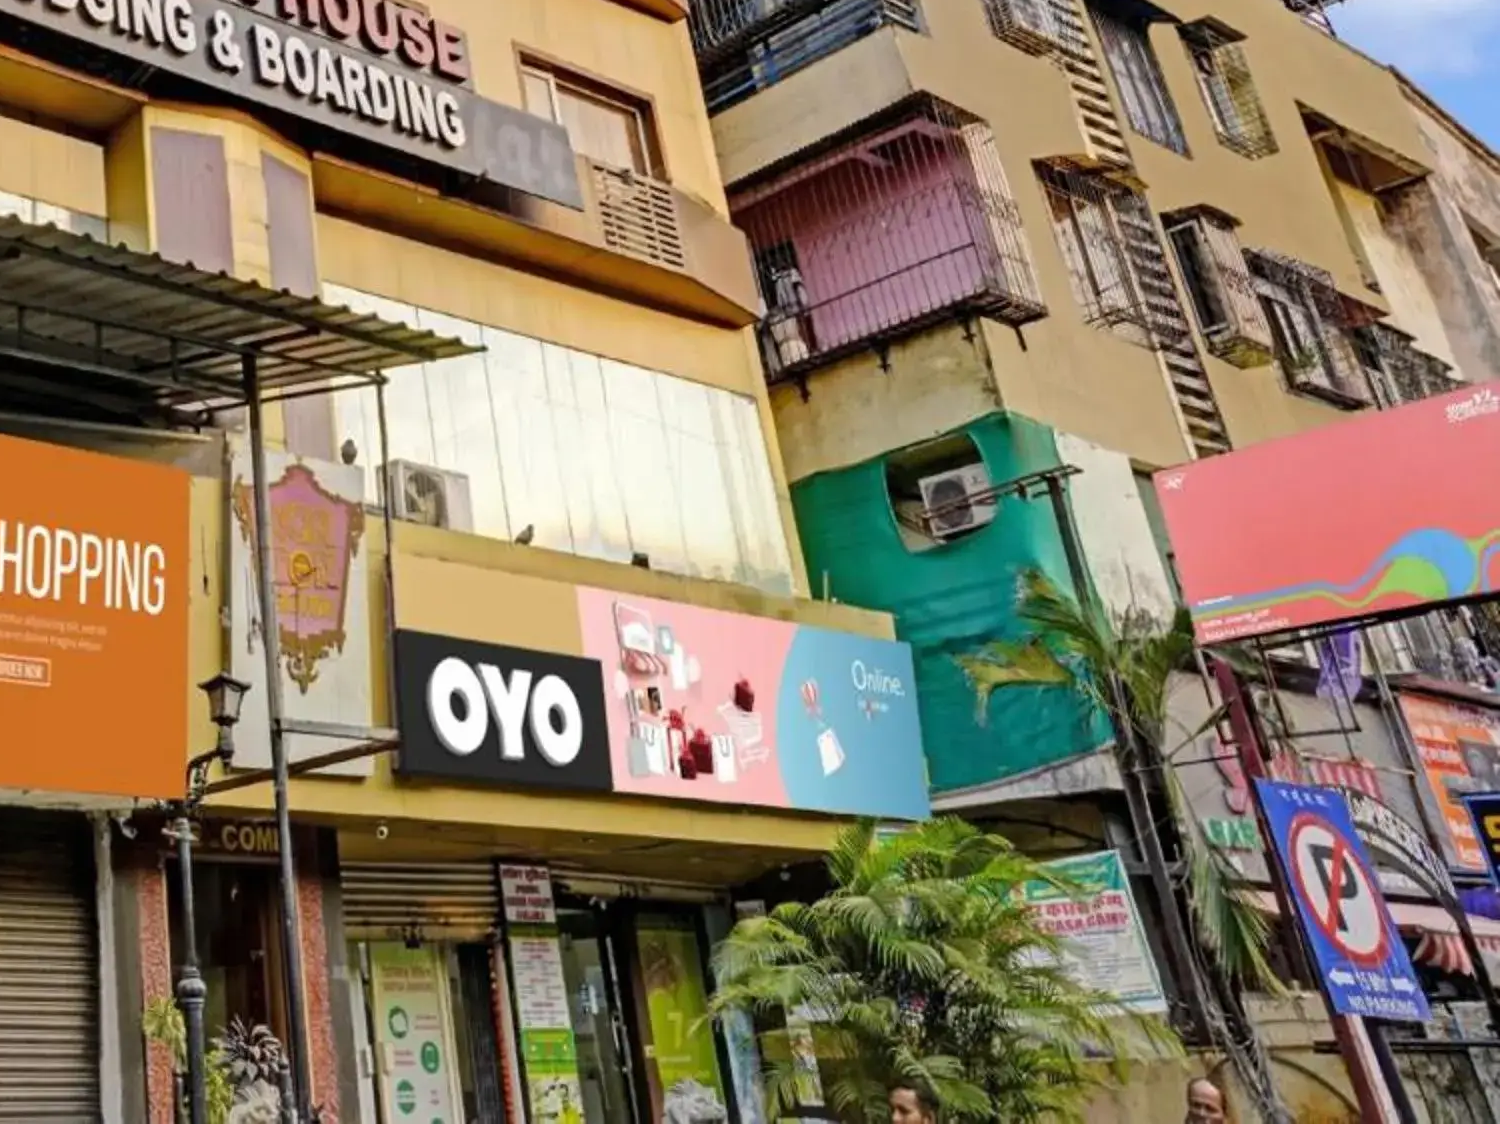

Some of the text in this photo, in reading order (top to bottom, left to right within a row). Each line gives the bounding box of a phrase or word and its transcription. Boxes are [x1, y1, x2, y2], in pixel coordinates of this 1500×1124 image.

[207, 9, 243, 74] &
[249, 23, 467, 150] BOARDING
[426, 655, 583, 767] OYO
